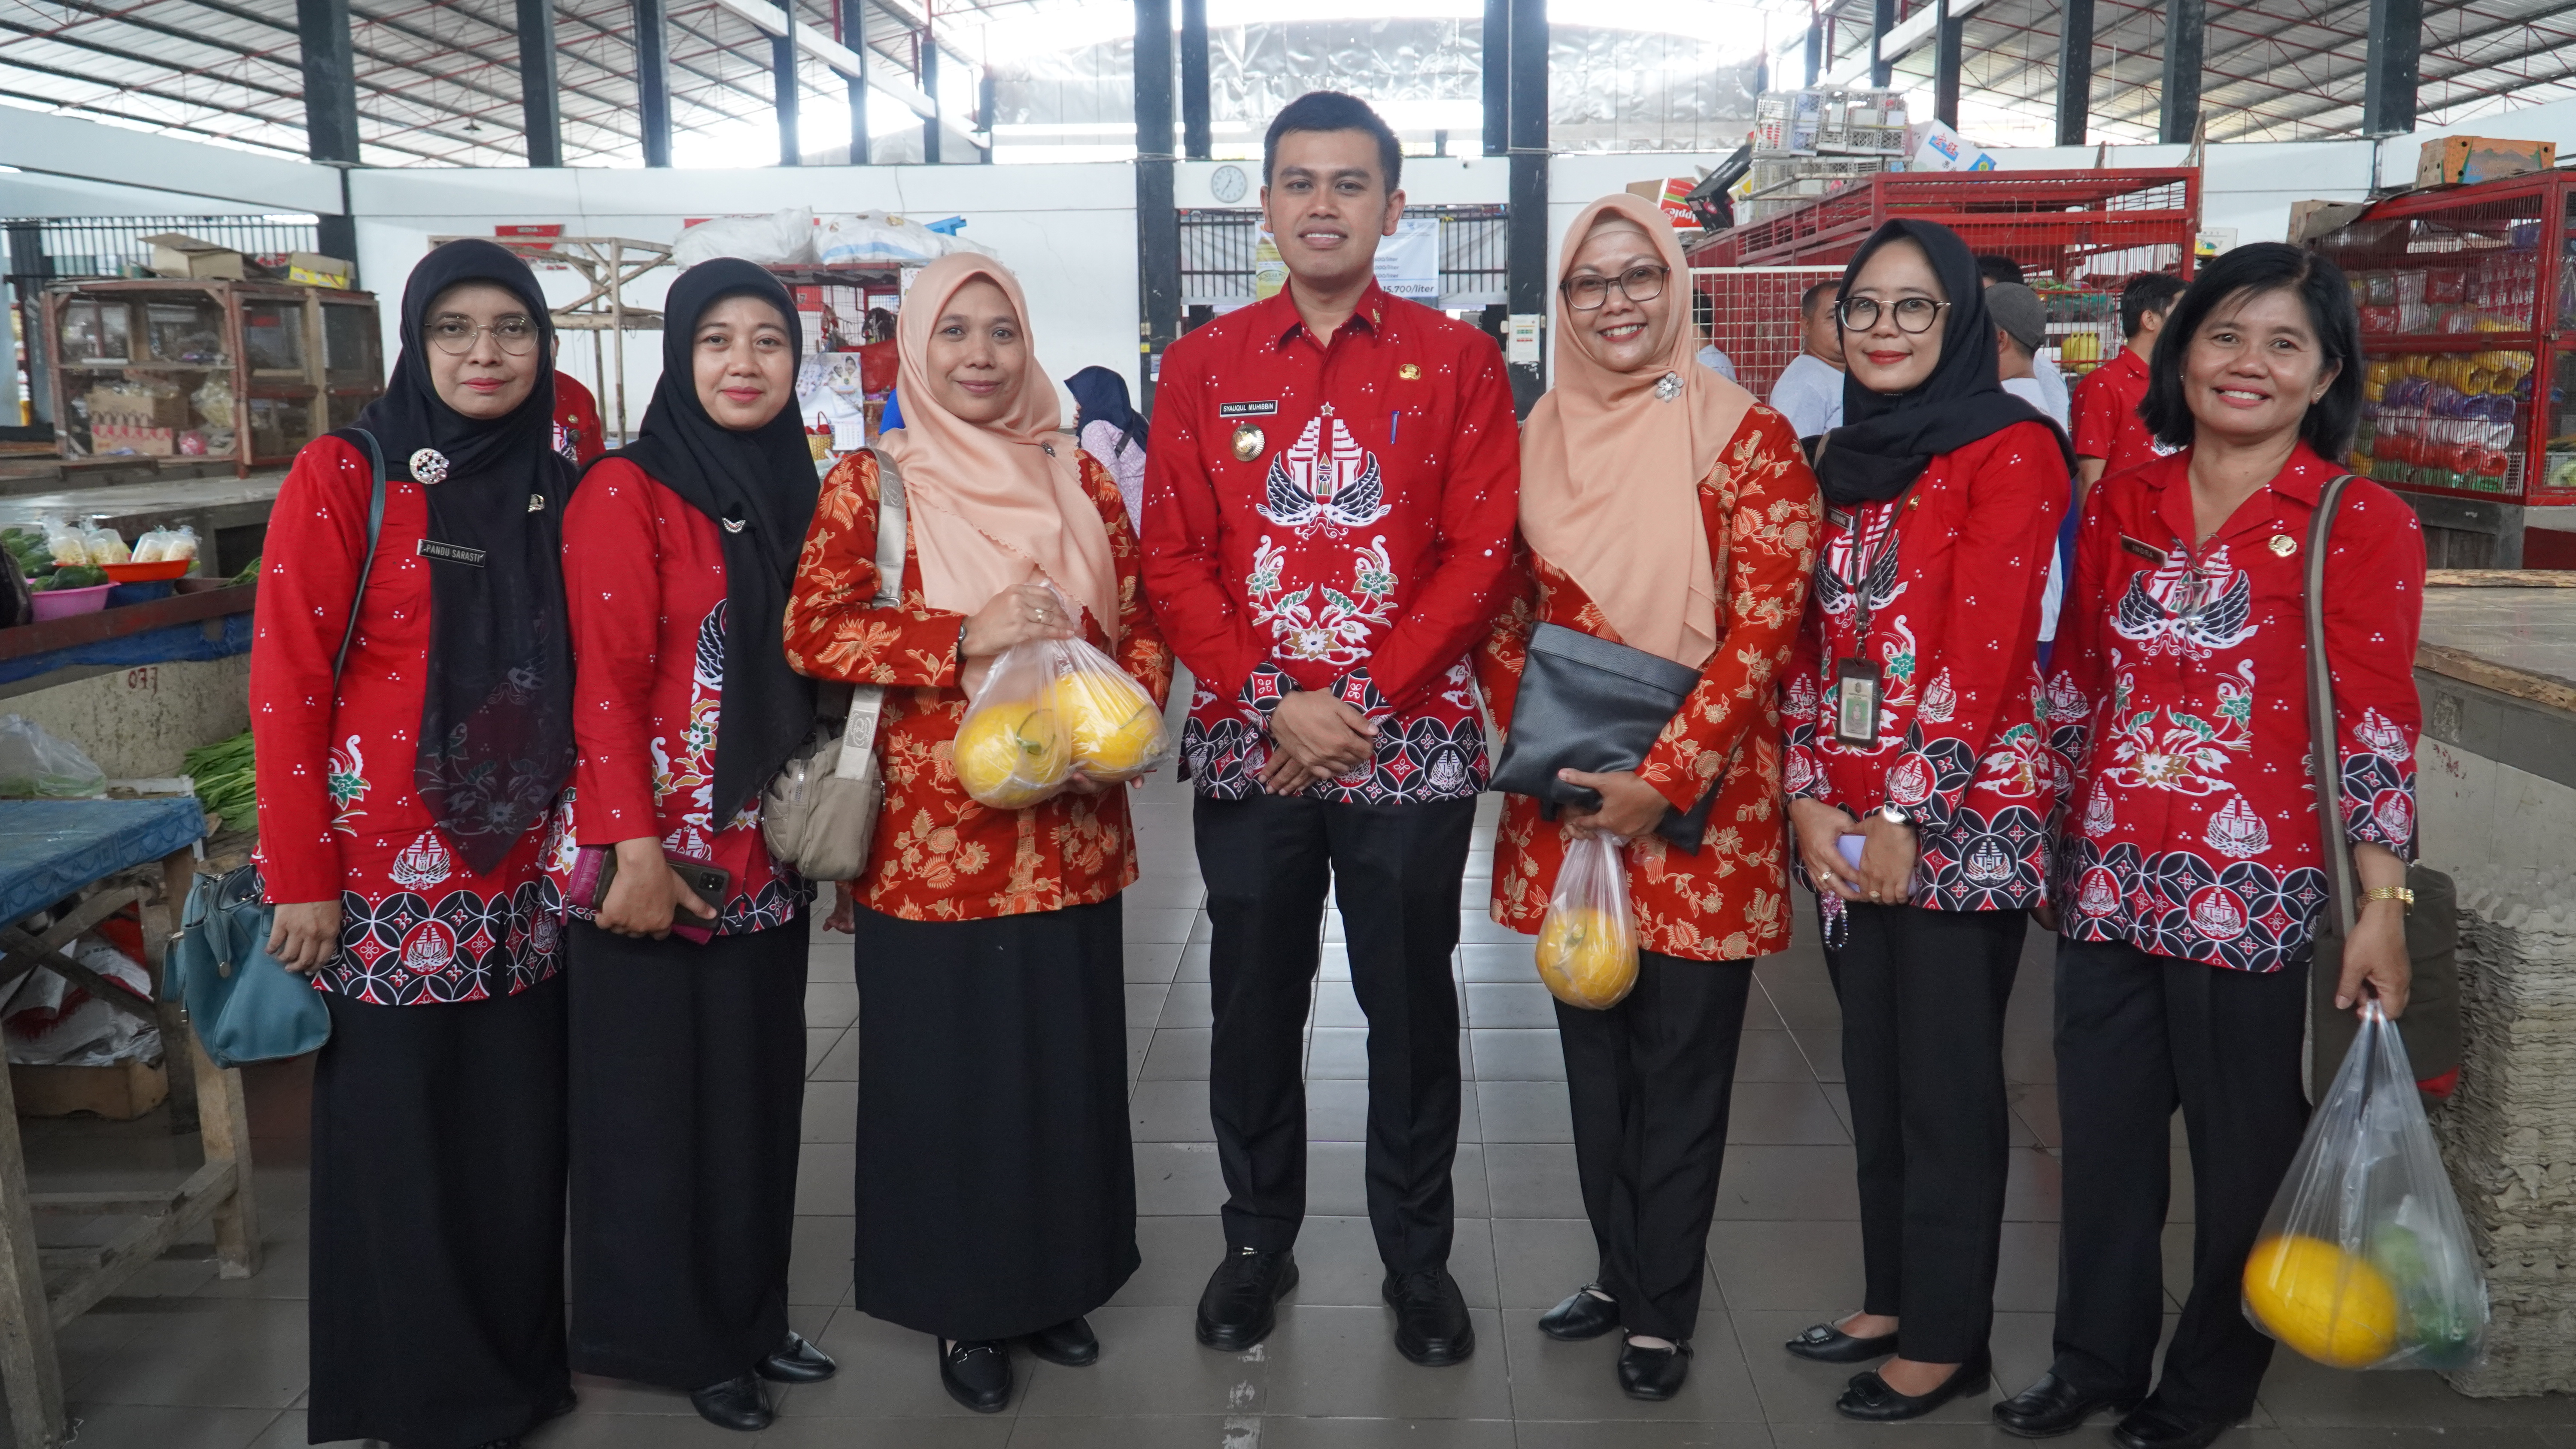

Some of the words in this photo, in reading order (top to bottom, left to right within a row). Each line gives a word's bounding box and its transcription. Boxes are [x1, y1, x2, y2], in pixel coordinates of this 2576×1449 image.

[425, 544, 450, 556] PANDU
[452, 549, 480, 562] SARASTI
[2132, 544, 2153, 558] INDRA
